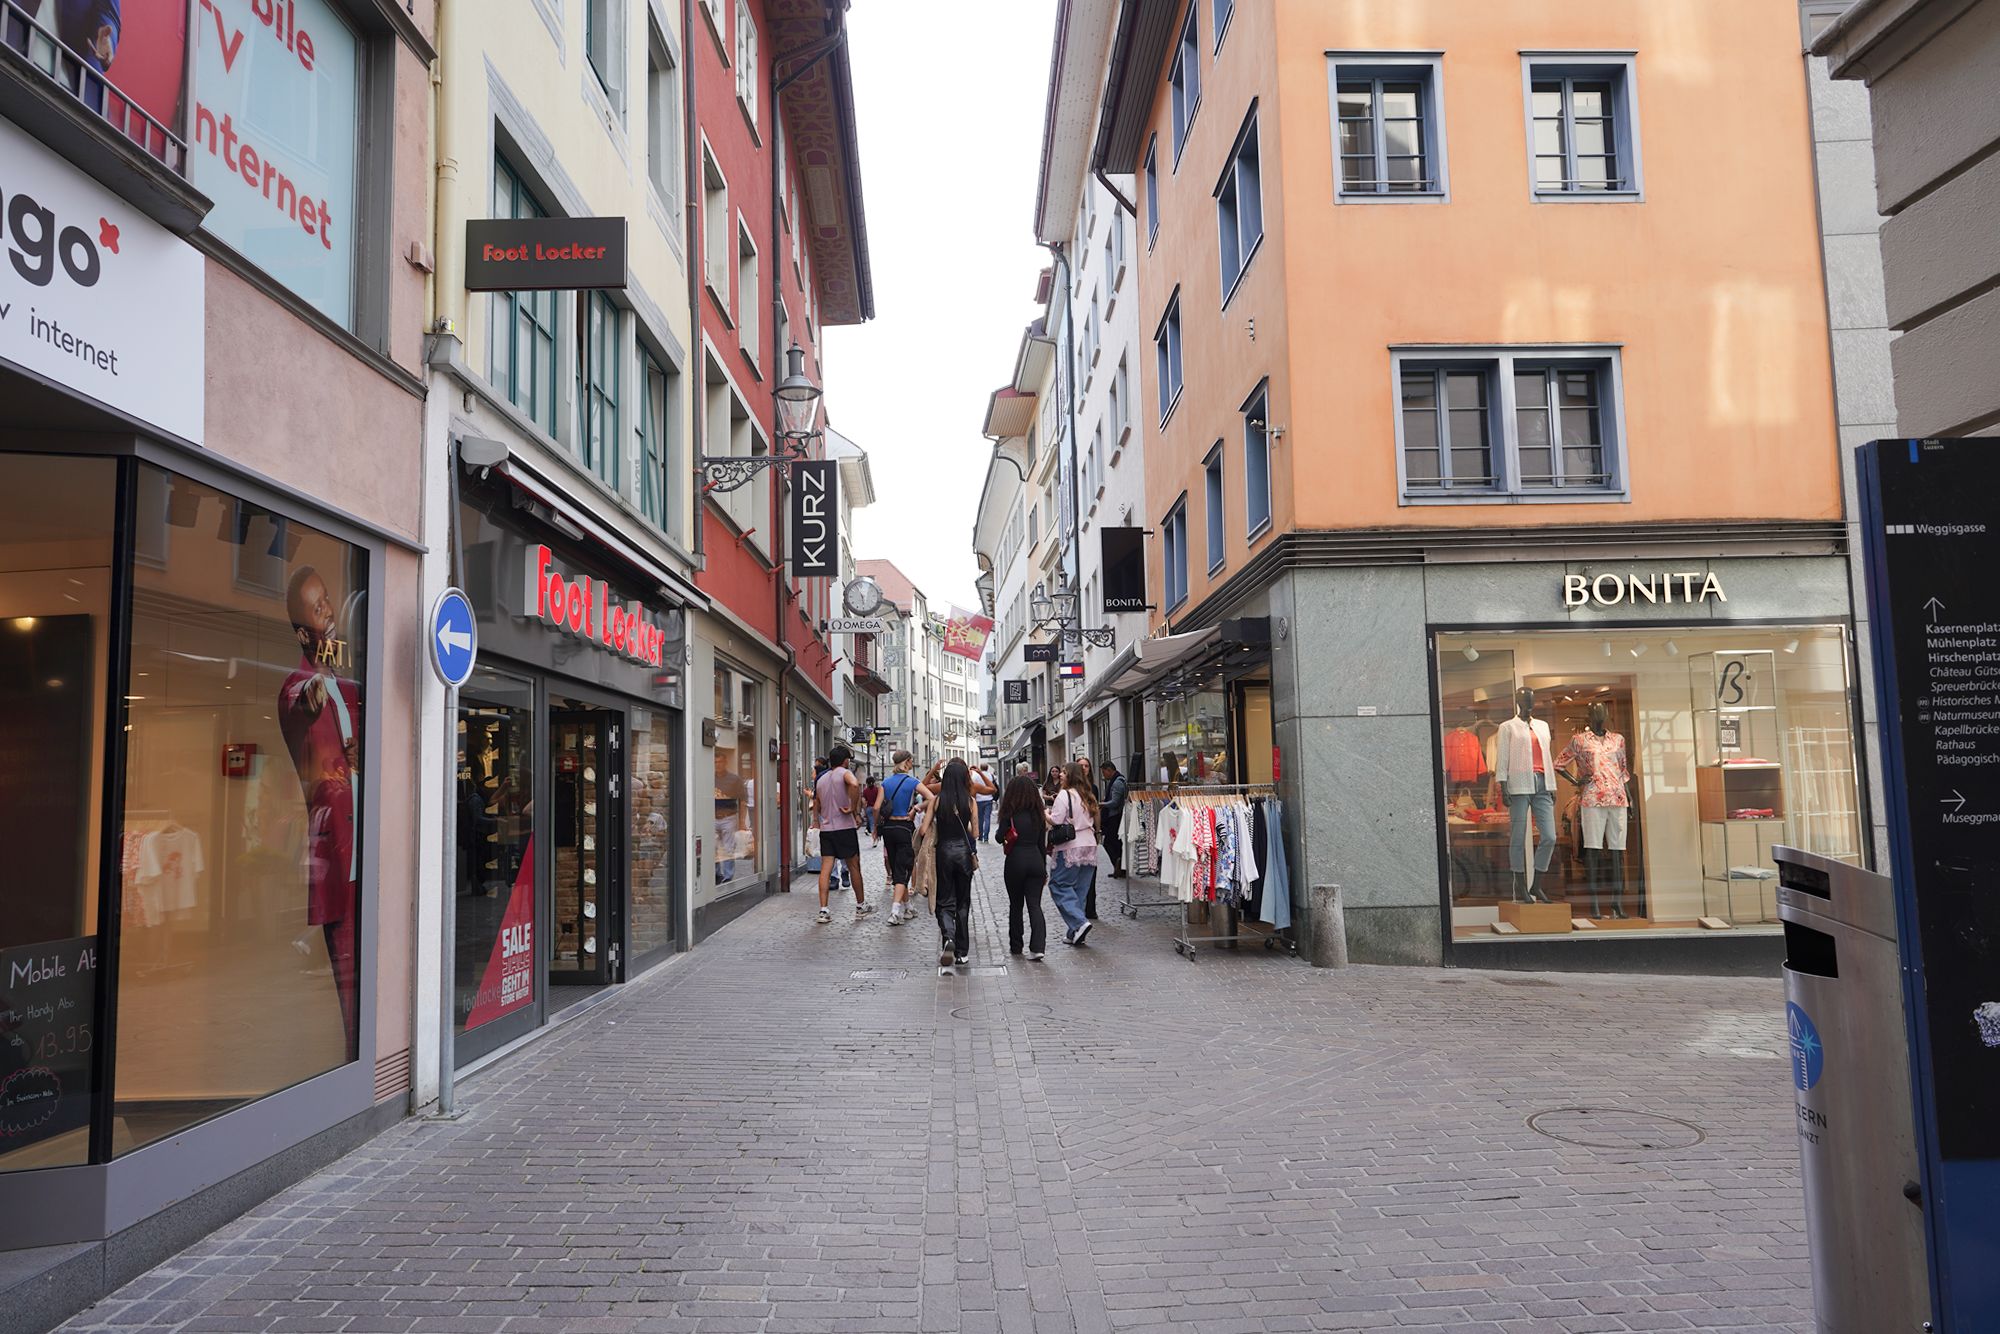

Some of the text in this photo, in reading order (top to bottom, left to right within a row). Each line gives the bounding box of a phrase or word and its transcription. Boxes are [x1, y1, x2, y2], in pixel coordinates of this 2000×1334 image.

[0, 183, 101, 288] go
[482, 241, 607, 261] Foot Locker
[30, 306, 119, 376] internet
[802, 469, 826, 567] KURZ
[1916, 523, 1986, 536] Weggisgasse
[1563, 571, 1728, 606] BONITA
[536, 543, 665, 669] Foot Locker
[1105, 598, 1143, 607] BONITA
[843, 621, 881, 630] OMEGA
[1925, 622, 2000, 635] Kasernenplat
[1927, 637, 1997, 649] Mühlenplatz
[1929, 667, 1971, 677] Château
[1932, 695, 1992, 706] Historisches
[1935, 724, 2000, 737] Kapellbrücke
[1936, 740, 1976, 750] Rathaus
[1937, 753, 2000, 766] Pädagogisch
[1942, 813, 2000, 825] Museggma
[502, 923, 531, 958] SALE
[10, 955, 66, 989] Mobile
